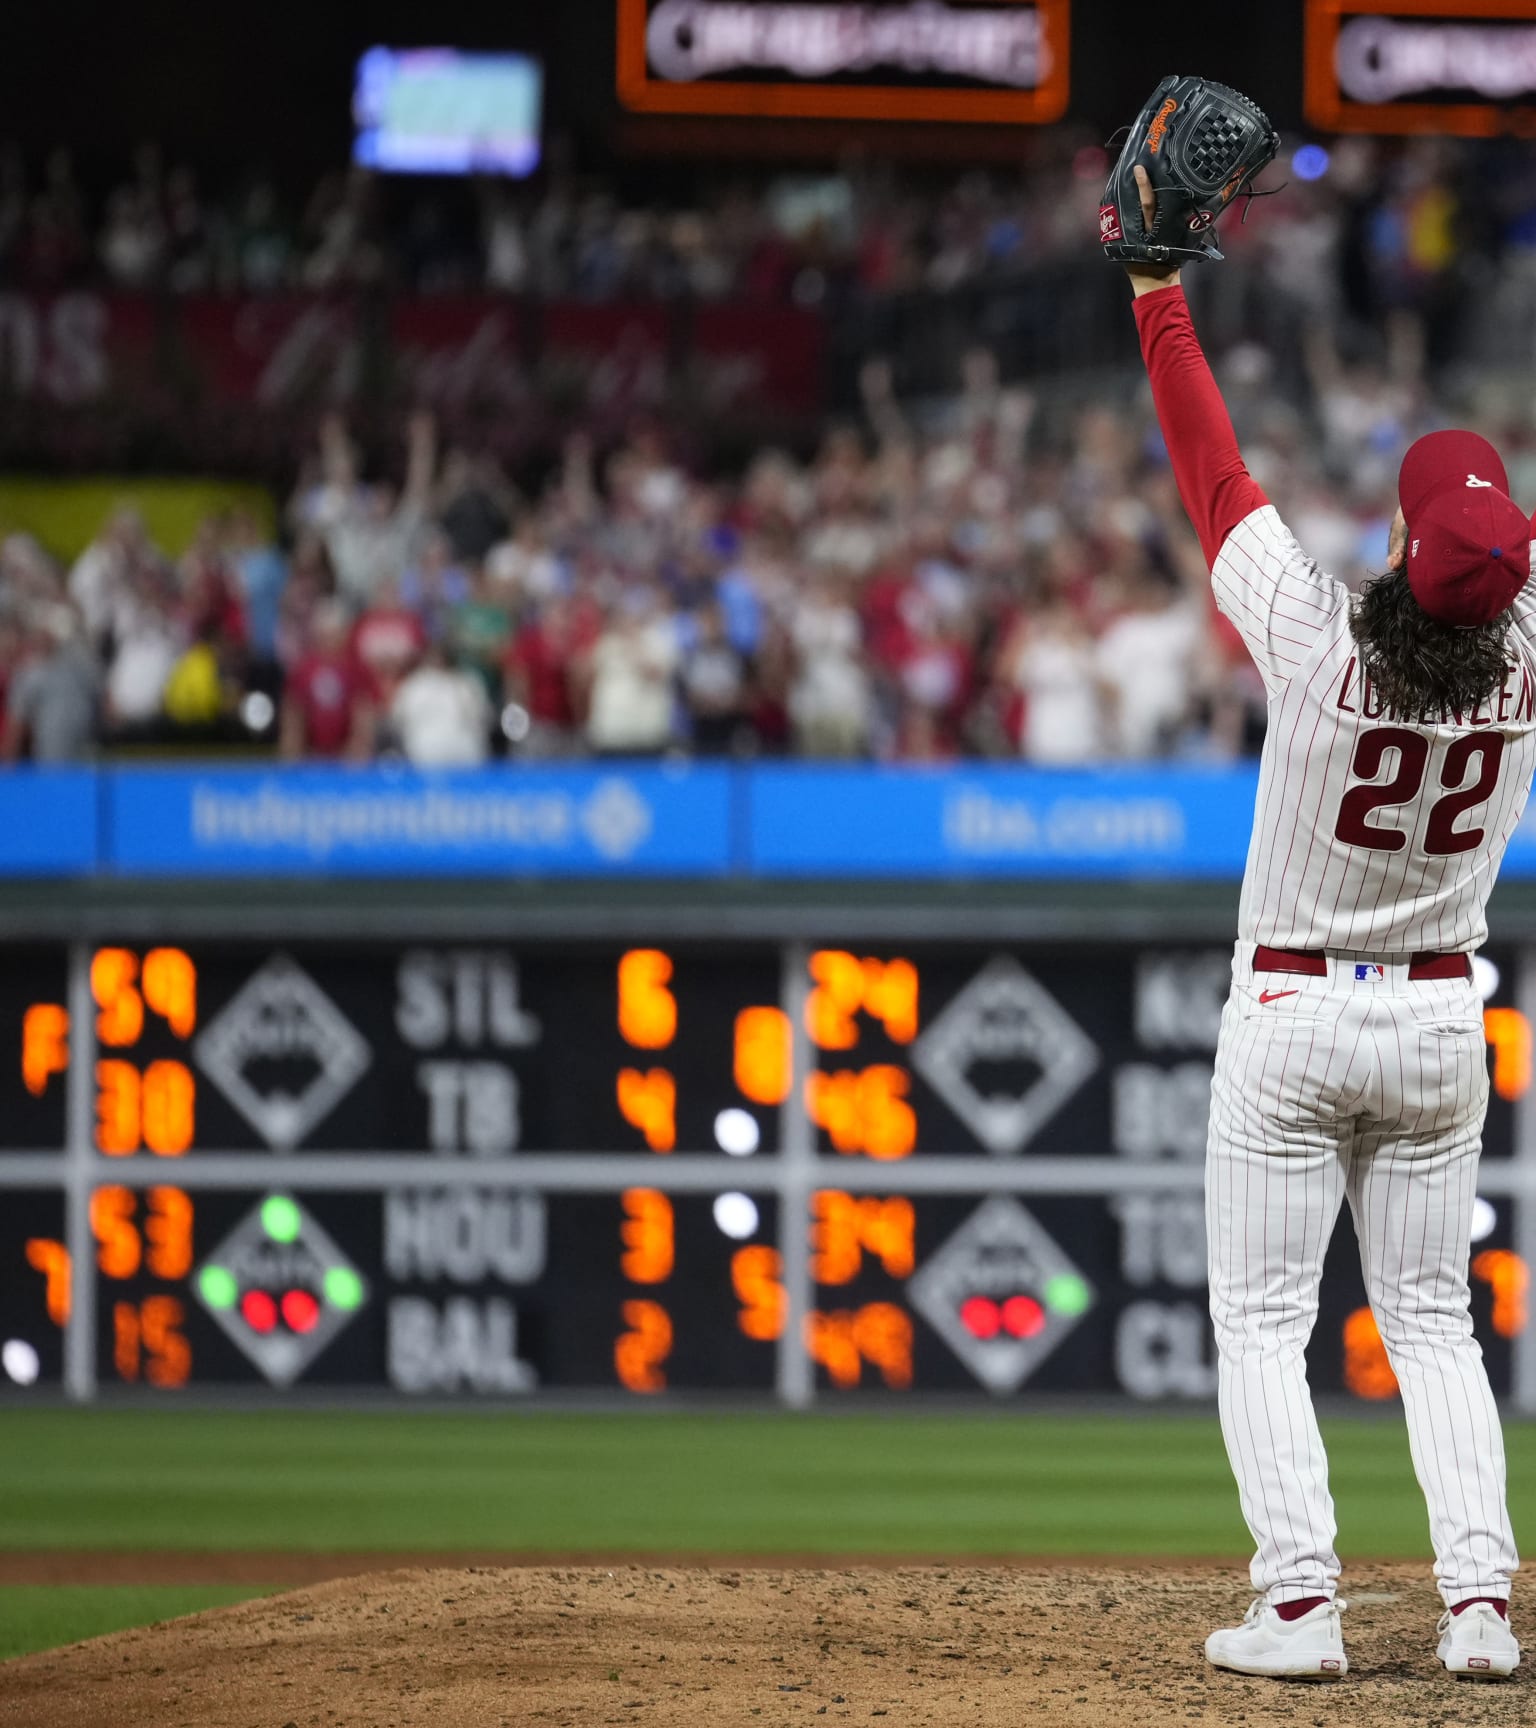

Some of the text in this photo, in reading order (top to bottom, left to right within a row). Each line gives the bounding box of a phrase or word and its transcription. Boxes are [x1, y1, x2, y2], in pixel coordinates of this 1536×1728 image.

[1336, 655, 1535, 726] LOEN
[193, 780, 570, 856] Independence
[1335, 728, 1504, 855] 22
[90, 948, 196, 1047] 59
[398, 955, 540, 1046] STL
[618, 949, 677, 1049] 6
[95, 1059, 195, 1156] 30
[418, 1062, 518, 1153] TB
[617, 1068, 676, 1153] 4
[1112, 1064, 1212, 1154] BO
[91, 1184, 193, 1279] 53
[386, 1190, 546, 1283] HOU
[621, 1187, 674, 1283] 3
[1108, 1195, 1208, 1286] TO
[731, 1245, 789, 1340] 5
[114, 1296, 192, 1389] 15
[388, 1299, 538, 1391] BAL
[614, 1300, 673, 1393] 2
[1114, 1302, 1218, 1394] CL
